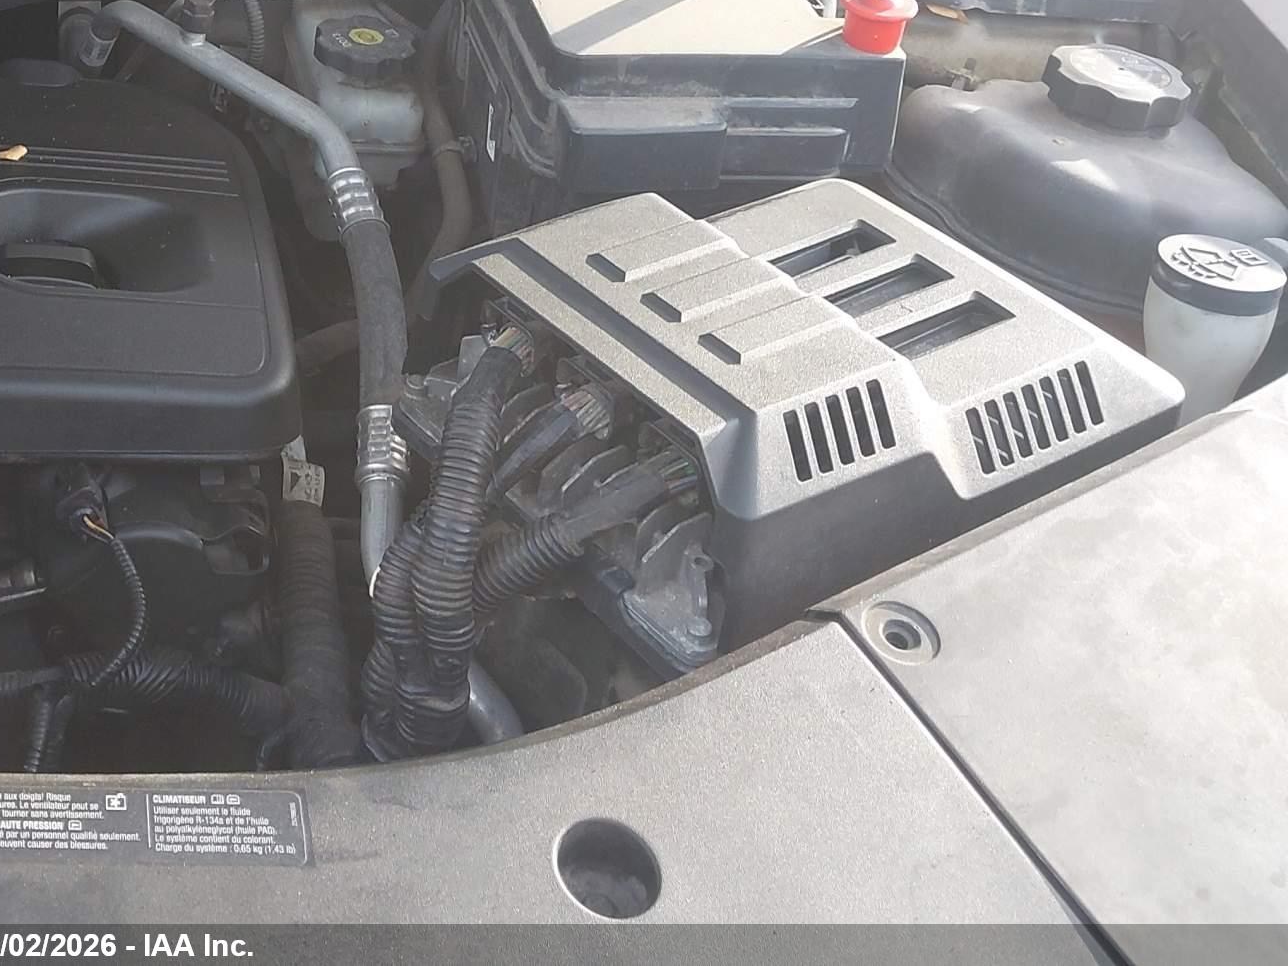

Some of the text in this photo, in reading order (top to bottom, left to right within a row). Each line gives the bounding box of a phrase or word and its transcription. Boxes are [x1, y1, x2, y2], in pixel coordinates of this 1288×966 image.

[46, 793, 71, 802] Risque
[72, 802, 88, 810] peut
[154, 806, 179, 814] Utiliser
[50, 811, 104, 819] avertissement.
[196, 816, 223, 824] R-134a
[23, 821, 64, 830] PRESSION
[236, 826, 256, 834] (huile
[6, 831, 18, 839] par
[32, 832, 68, 840] personnel
[100, 832, 140, 841] seulement.
[200, 835, 229, 843] contient
[70, 841, 108, 849] blessures.
[156, 844, 182, 853] Charge
[253, 846, 262, 854] kg
[286, 843, 296, 854] lb)
